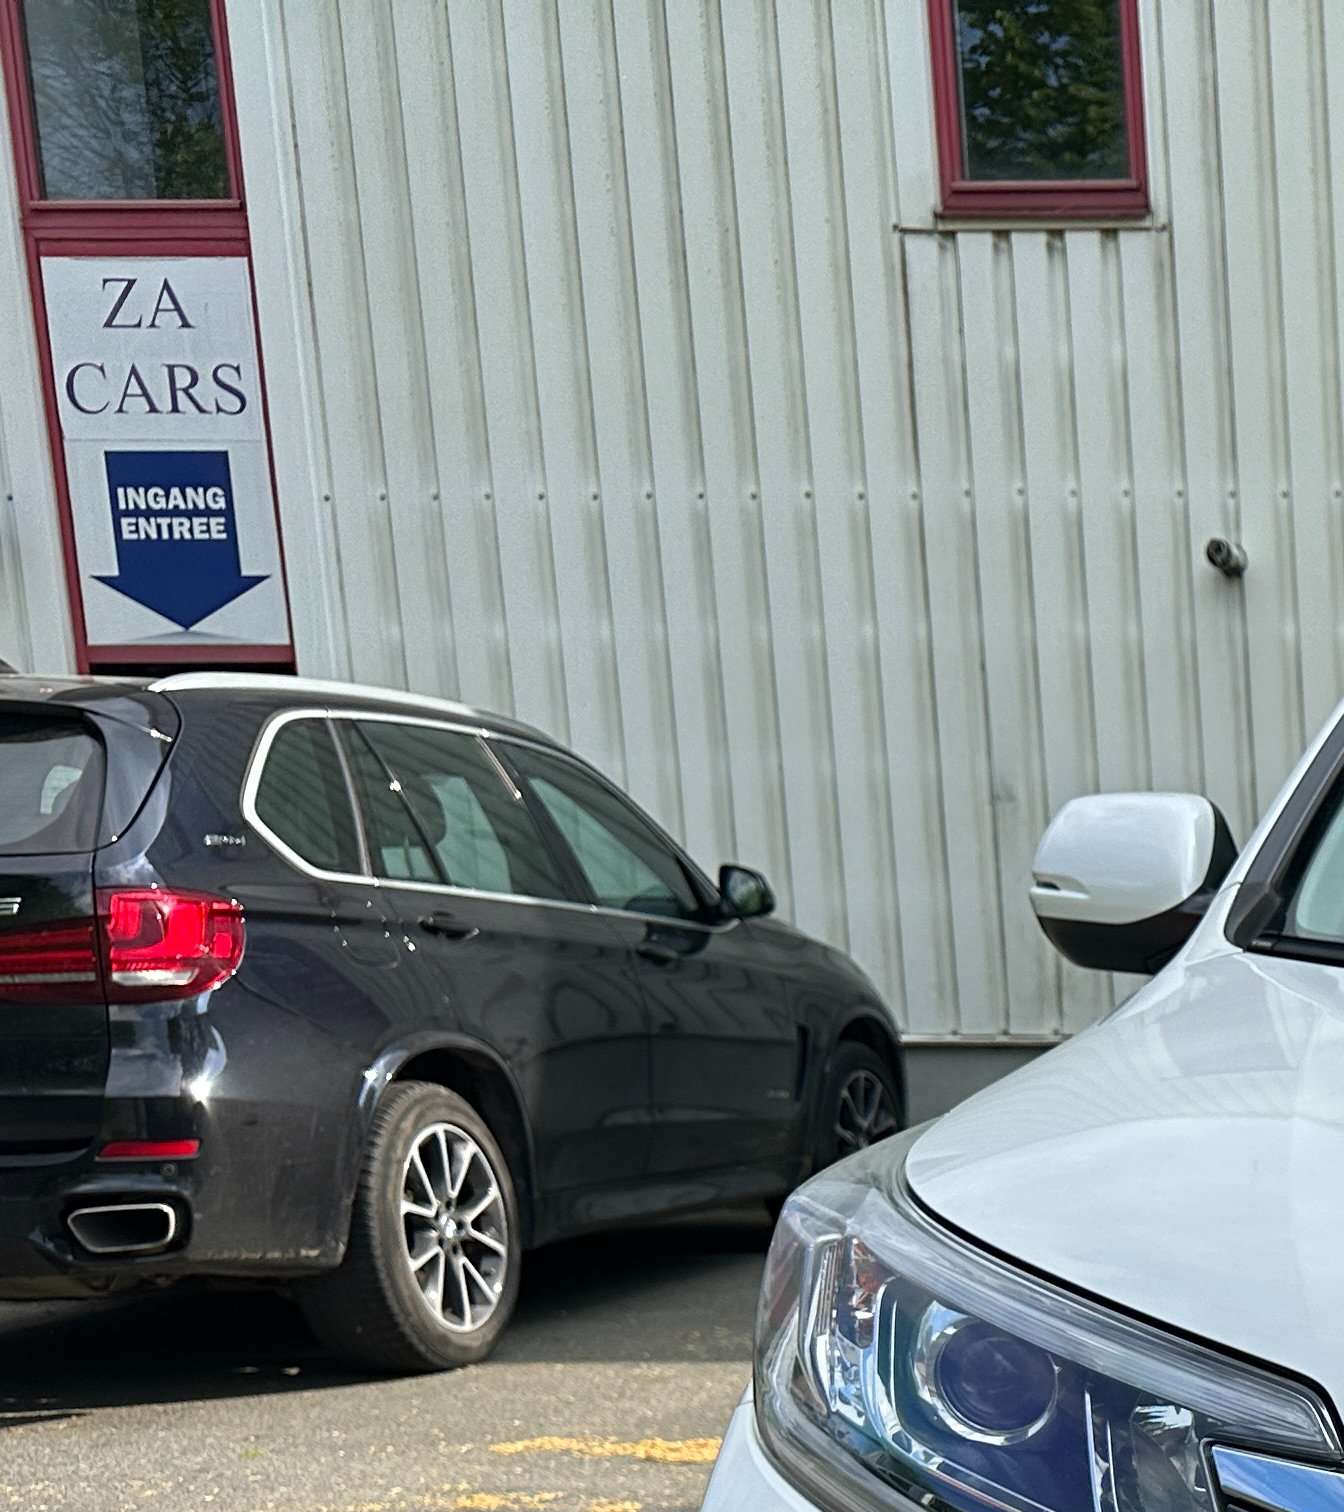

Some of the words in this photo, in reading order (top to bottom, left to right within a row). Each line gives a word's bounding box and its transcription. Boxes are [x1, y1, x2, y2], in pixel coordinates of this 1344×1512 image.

[101, 277, 195, 329] ZA
[65, 362, 248, 416] CARS
[117, 486, 226, 511] INGANG
[121, 516, 227, 541] ENTREE
